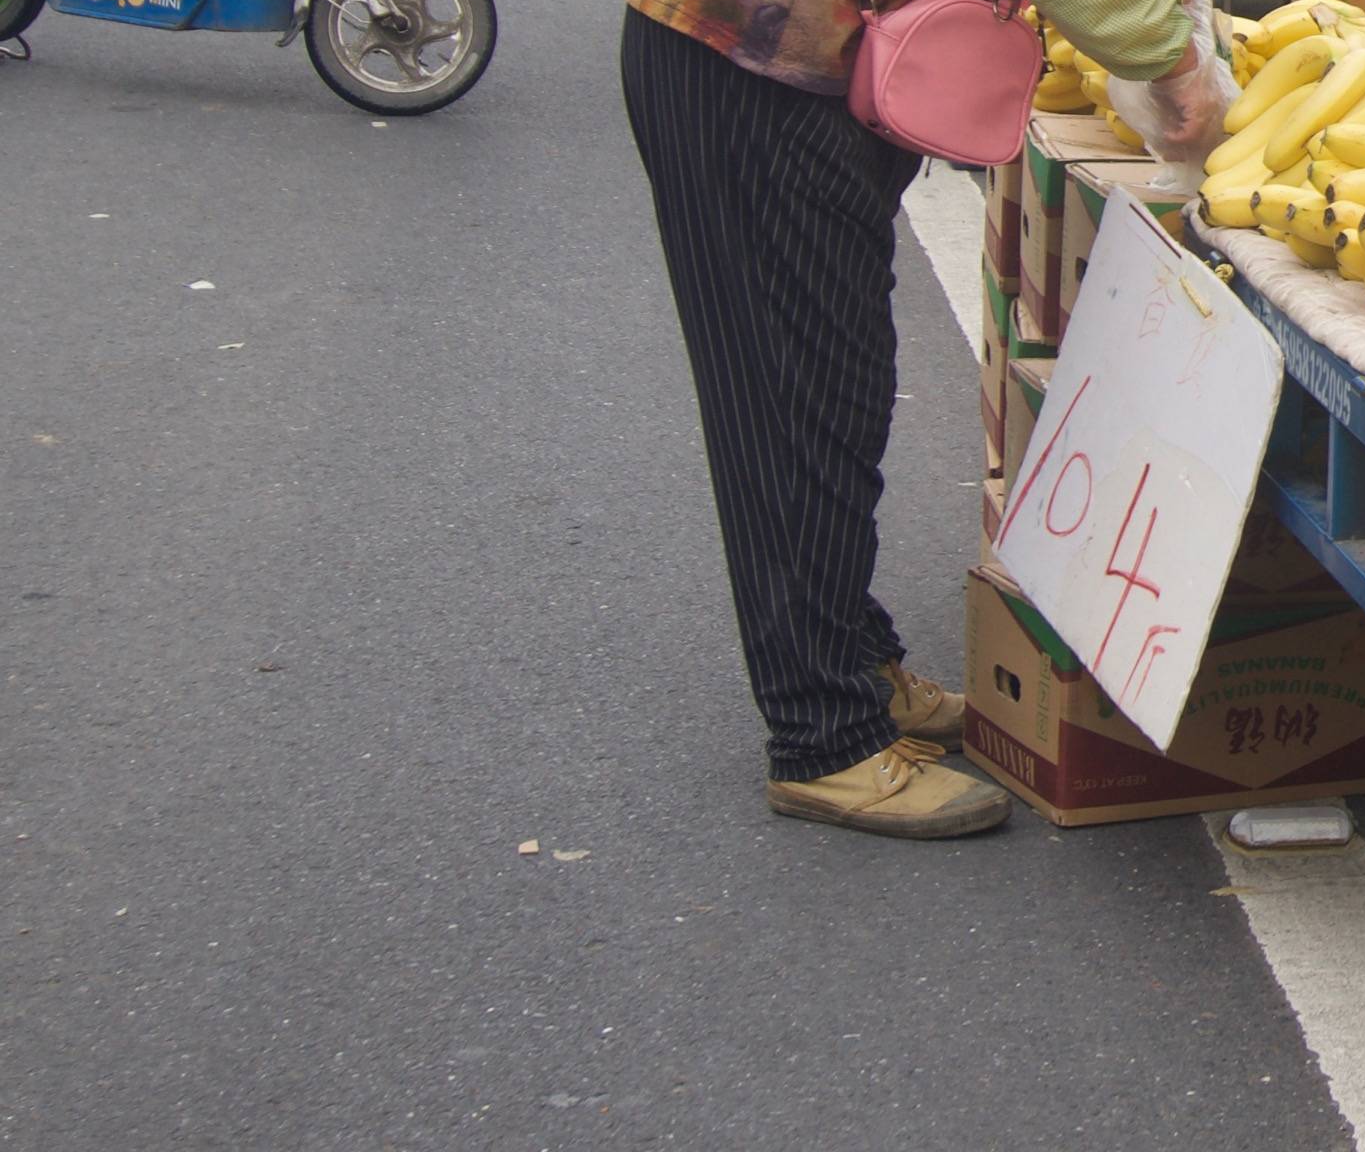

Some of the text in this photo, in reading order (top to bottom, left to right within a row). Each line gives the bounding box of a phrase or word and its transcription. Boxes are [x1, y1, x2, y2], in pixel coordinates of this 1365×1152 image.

[1217, 655, 1326, 678] BANANAS
[977, 719, 1036, 787] BANANAS
[1224, 702, 1321, 755] 纳福
